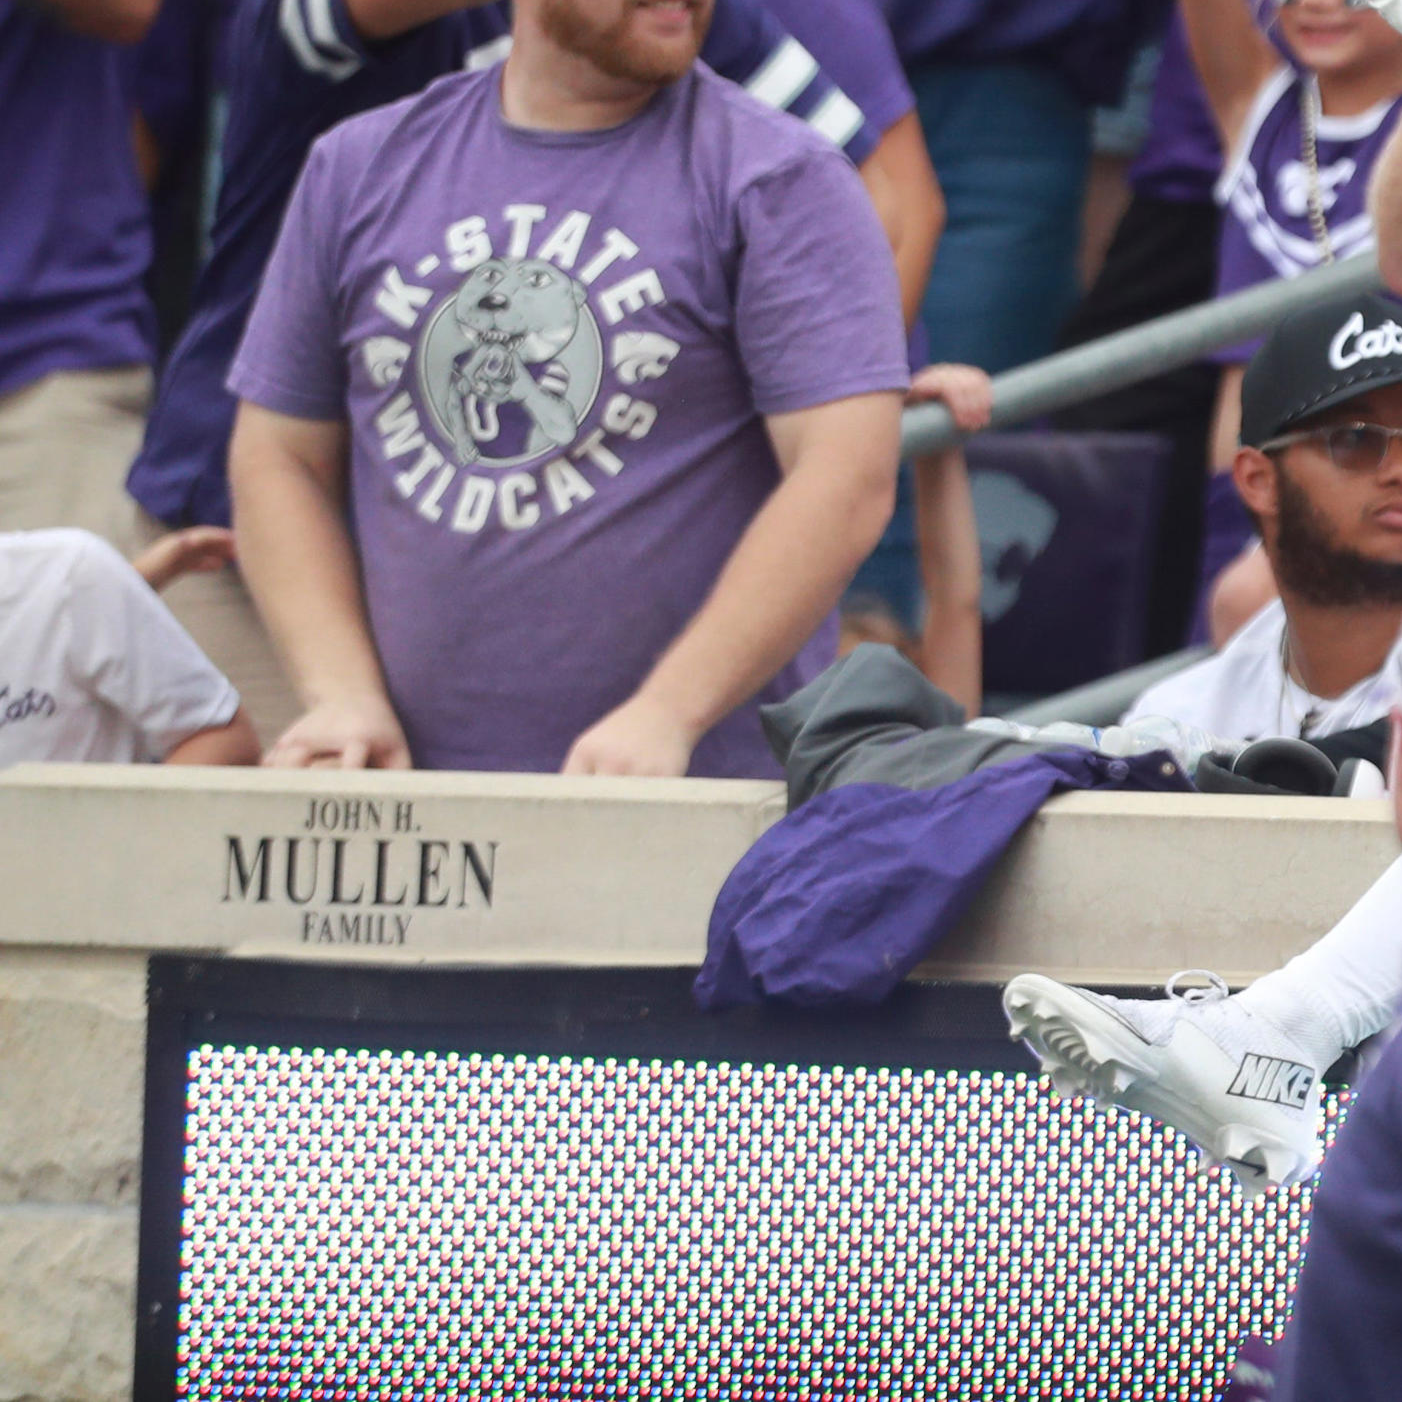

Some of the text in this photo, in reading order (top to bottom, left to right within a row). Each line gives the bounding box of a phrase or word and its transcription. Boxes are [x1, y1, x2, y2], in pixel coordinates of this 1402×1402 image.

[374, 202, 668, 329] K-STATE
[375, 389, 659, 535] WILDCATS
[304, 799, 422, 833] JOHN H.
[220, 834, 500, 909] MULLEN
[302, 912, 413, 946] FAMILY
[1225, 1051, 1316, 1110] NIKE
